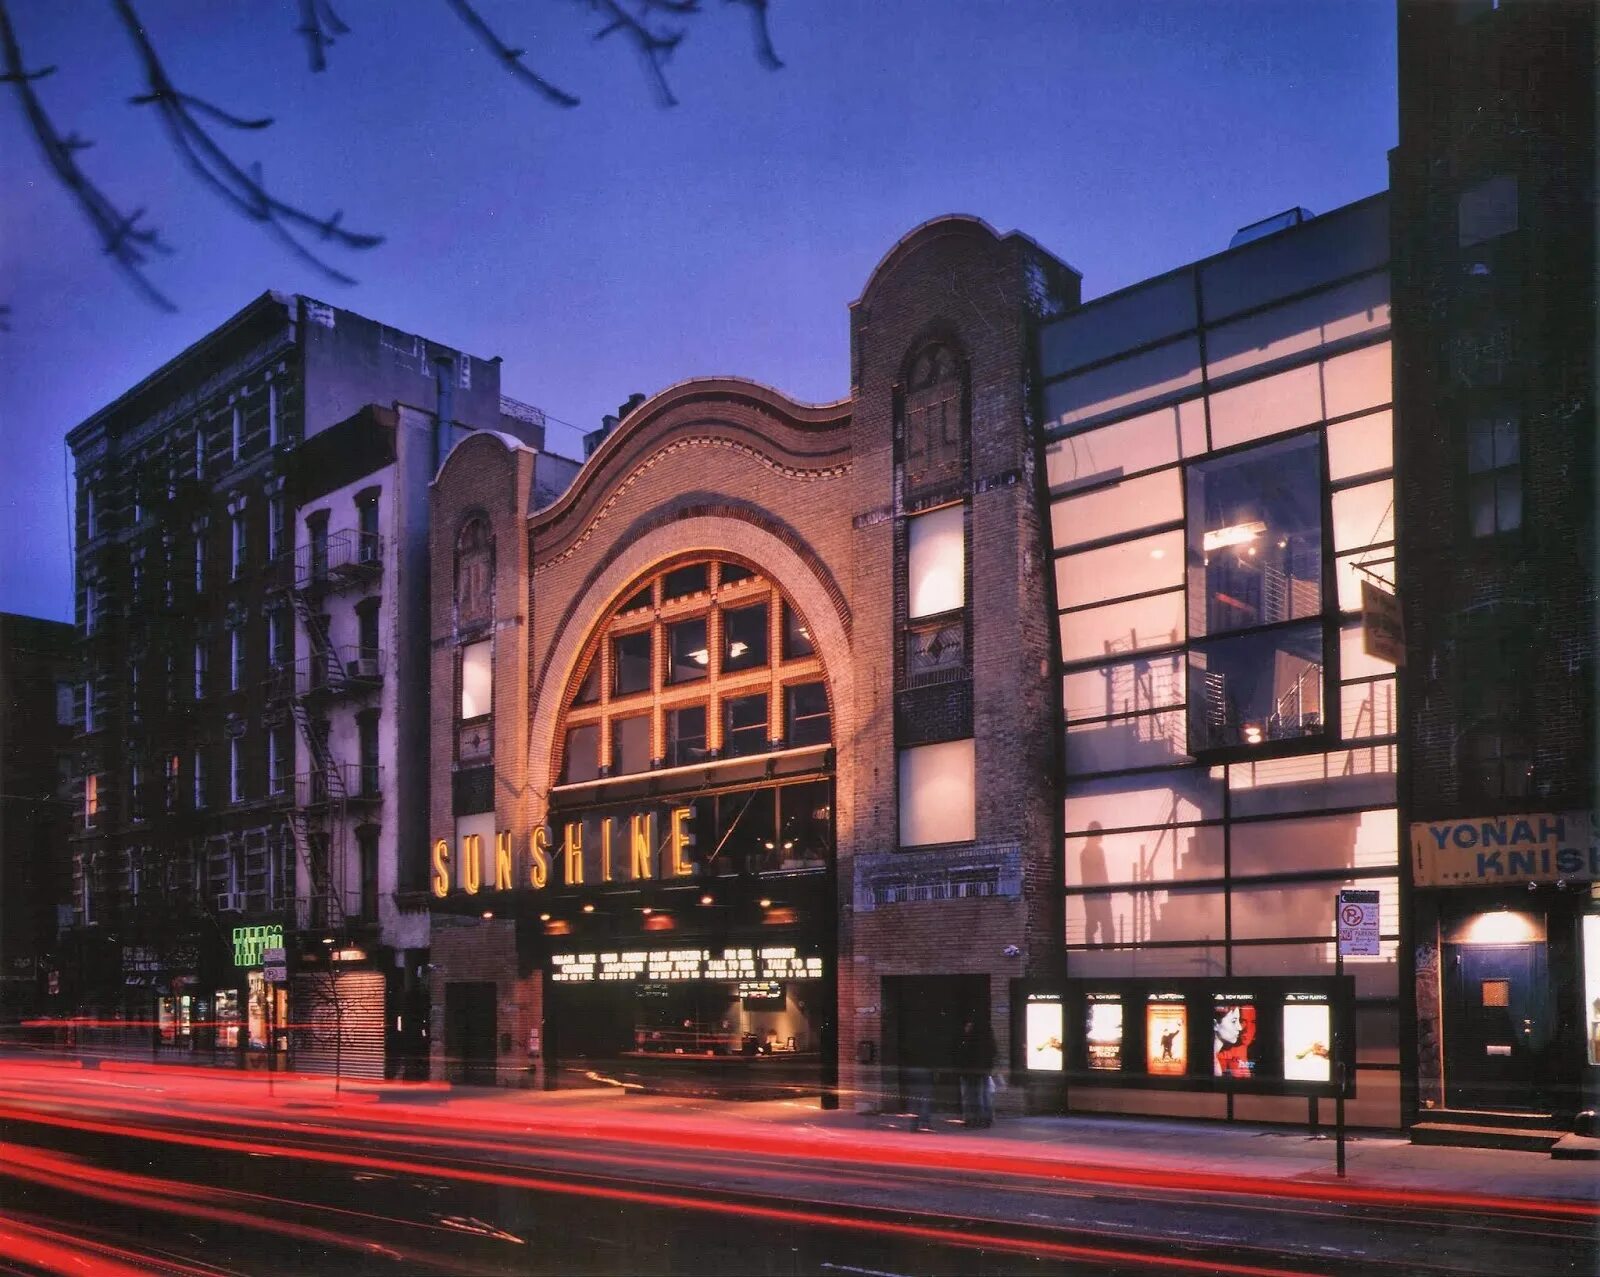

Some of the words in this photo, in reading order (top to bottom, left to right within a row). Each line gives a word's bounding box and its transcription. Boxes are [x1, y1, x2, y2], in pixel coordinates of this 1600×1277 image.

[1429, 817, 1566, 849] YONAH
[432, 807, 697, 898] SUNSHINE
[768, 959, 787, 970] TALK
[791, 958, 803, 970] TO
